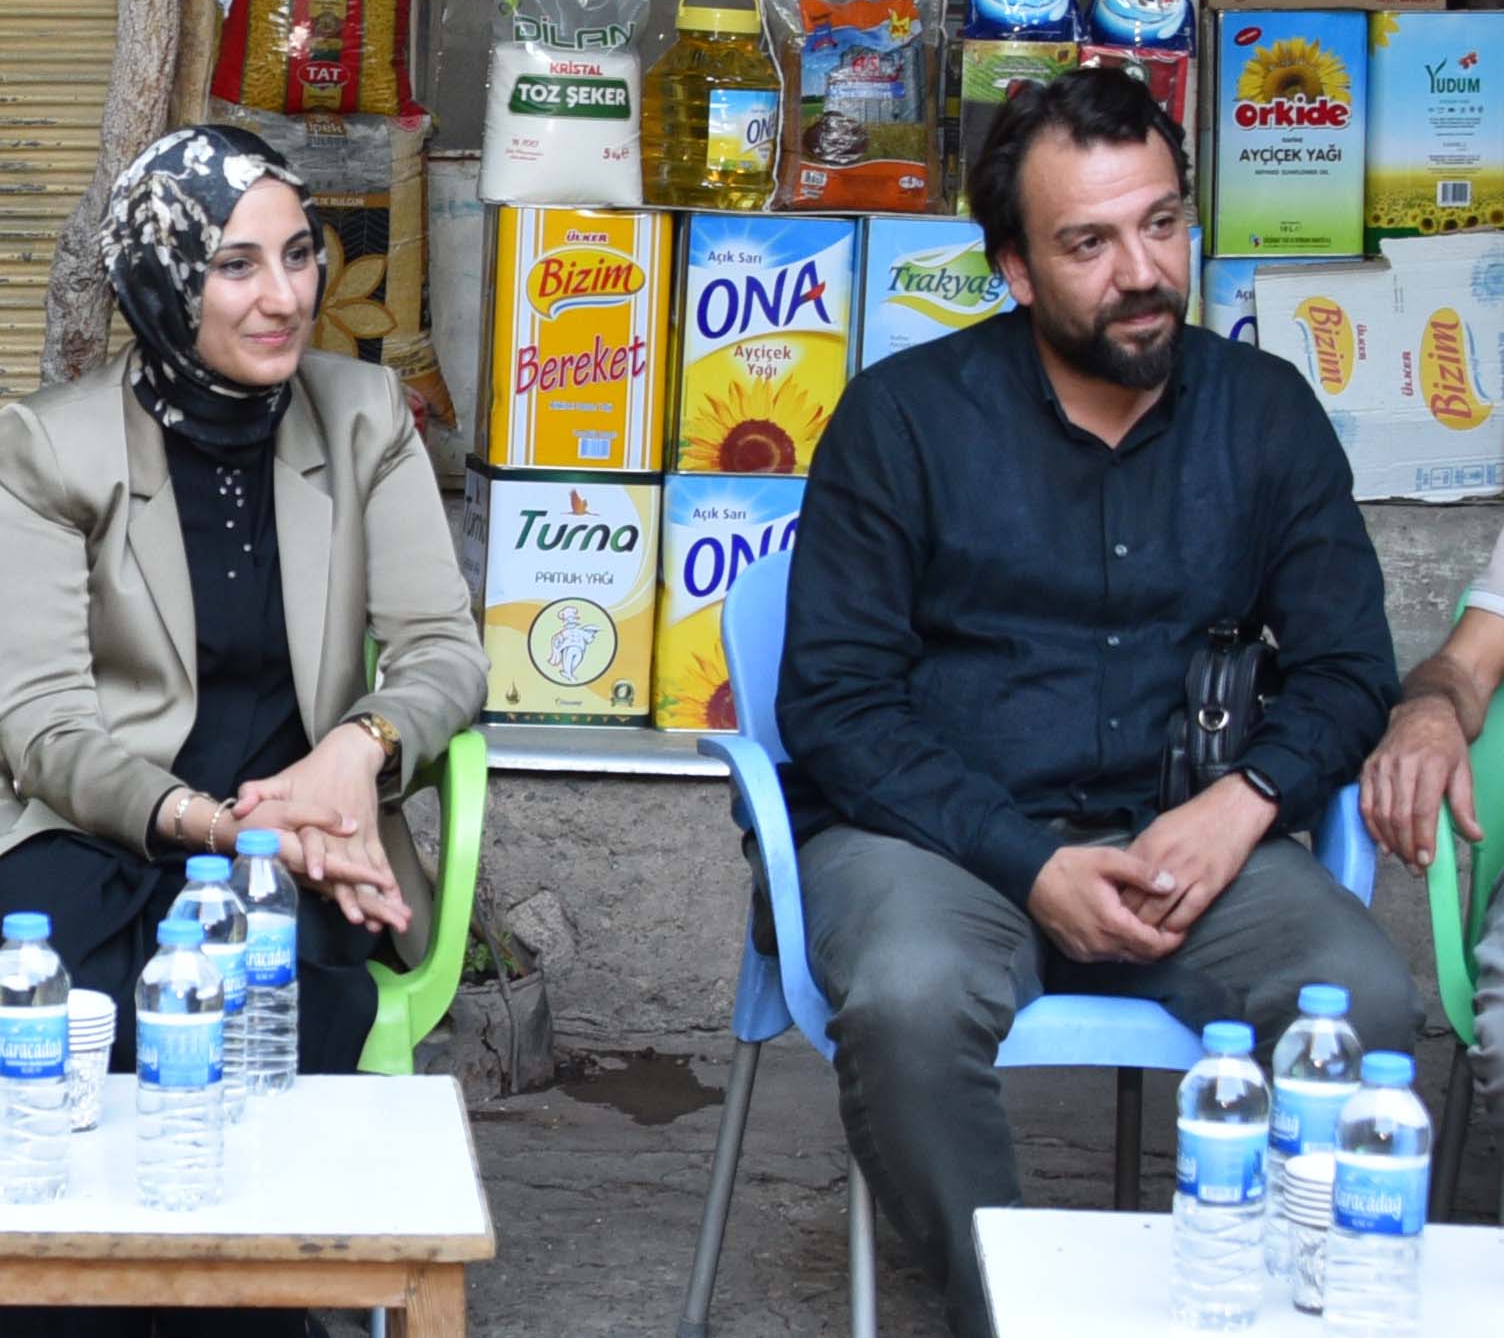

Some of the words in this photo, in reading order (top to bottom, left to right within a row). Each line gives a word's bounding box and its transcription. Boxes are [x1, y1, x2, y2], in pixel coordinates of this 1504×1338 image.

[513, 14, 637, 51] DİLAN
[305, 66, 342, 82] TAT
[549, 60, 603, 77] KRİSTAL
[1424, 57, 1481, 95] YUDUM
[518, 83, 561, 102] TOZ
[565, 85, 626, 108] ŞEKER
[1239, 145, 1302, 166] AYÇİÇEK
[1307, 144, 1342, 162] YAĞI
[565, 229, 609, 244] ÜLKER
[708, 248, 734, 265] Açık
[738, 249, 762, 264] Sarı
[538, 252, 634, 301] Bizim
[696, 260, 833, 341] ONA
[733, 344, 792, 363] Ayçiçek
[1308, 304, 1345, 385] Bizim
[514, 334, 648, 396] Bereket
[746, 361, 779, 379] Yağı
[1427, 317, 1474, 420] Bizim
[692, 506, 720, 522] Açık
[722, 508, 748, 521] Sarı
[513, 510, 639, 553] Turna
[534, 571, 582, 586] PAMUK
[585, 569, 615, 586] YAĞI
